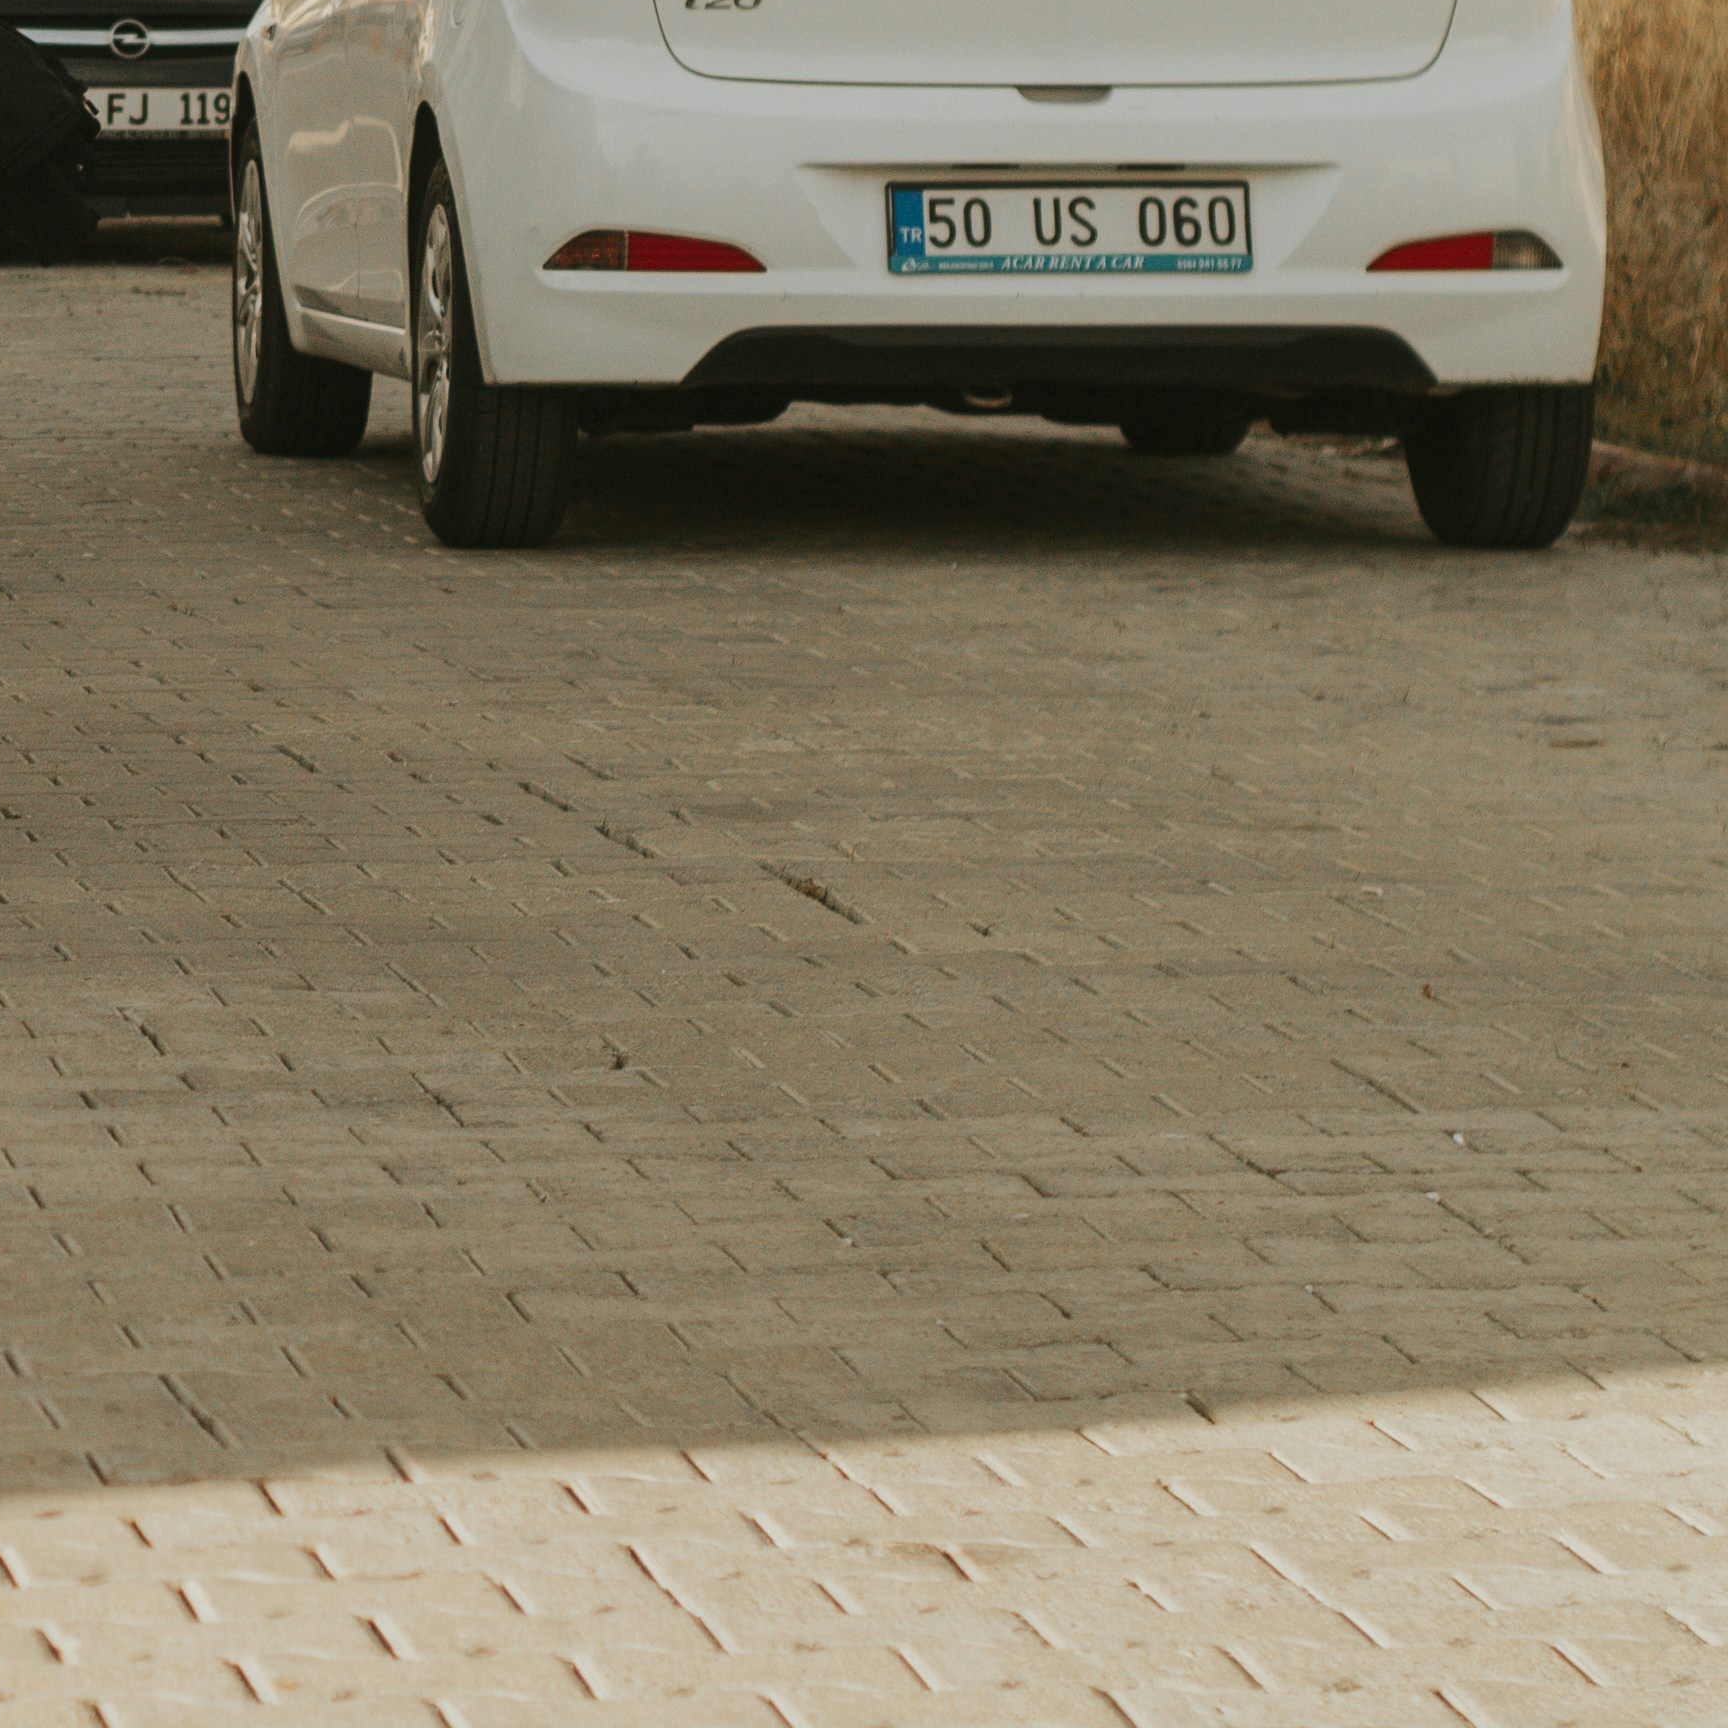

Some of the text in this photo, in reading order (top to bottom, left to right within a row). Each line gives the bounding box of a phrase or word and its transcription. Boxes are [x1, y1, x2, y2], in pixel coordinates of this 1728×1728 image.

[106, 92, 231, 126] FJ 119
[900, 226, 922, 242] TR
[928, 196, 1236, 248] 50 US 060
[1001, 255, 1044, 270] ACAR
[1048, 255, 1094, 270] RENT
[1096, 255, 1107, 269] A
[1110, 255, 1144, 269] CAR
